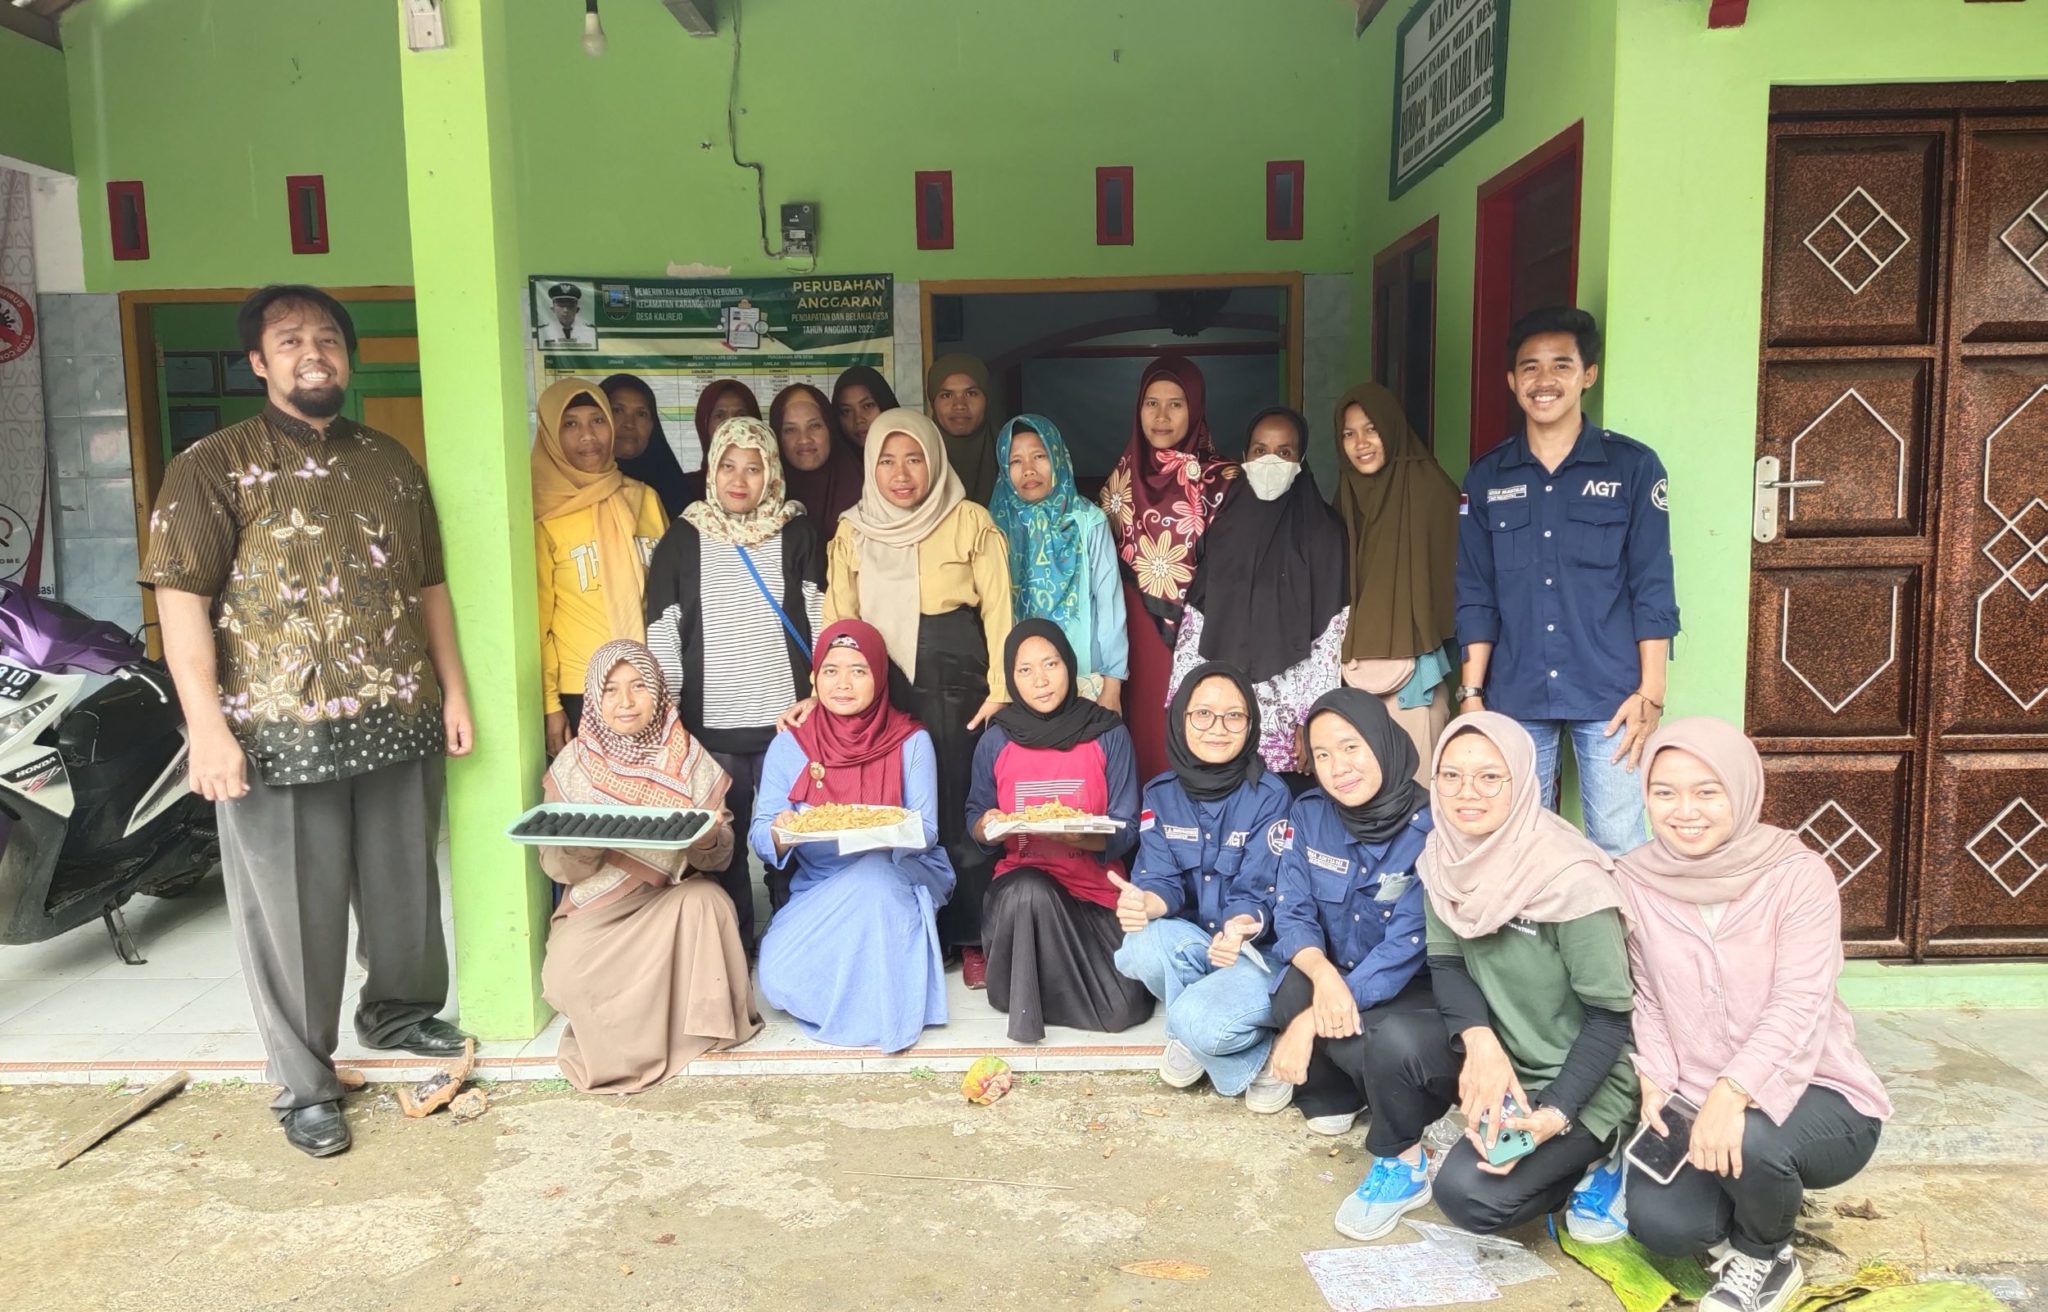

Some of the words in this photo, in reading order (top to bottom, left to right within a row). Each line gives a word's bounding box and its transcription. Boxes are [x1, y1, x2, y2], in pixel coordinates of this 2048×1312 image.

[1428, 0, 1467, 42] KANT
[1452, 16, 1474, 55] MILIK
[634, 287, 675, 297] PEMERINTAH
[675, 288, 712, 296] KABUPATEN
[713, 287, 744, 296] KEBUMEN
[792, 278, 886, 292] PERUBAHAN
[636, 299, 674, 308] KECAMATAN
[797, 295, 883, 309] ANGGARAN
[635, 312, 653, 321] DESA
[653, 312, 683, 321] KALIREJO
[791, 312, 831, 322] PENDAPATAN
[831, 312, 844, 321] DAN
[845, 312, 872, 321] BELANJA
[872, 311, 889, 320] DESA
[802, 325, 823, 335] TAHUN
[823, 325, 858, 334] ANGGARAN
[1582, 480, 1622, 498] AGT
[38, 583, 56, 595] asi
[15, 756, 57, 778] HONDA
[1225, 831, 1250, 848] AGT
